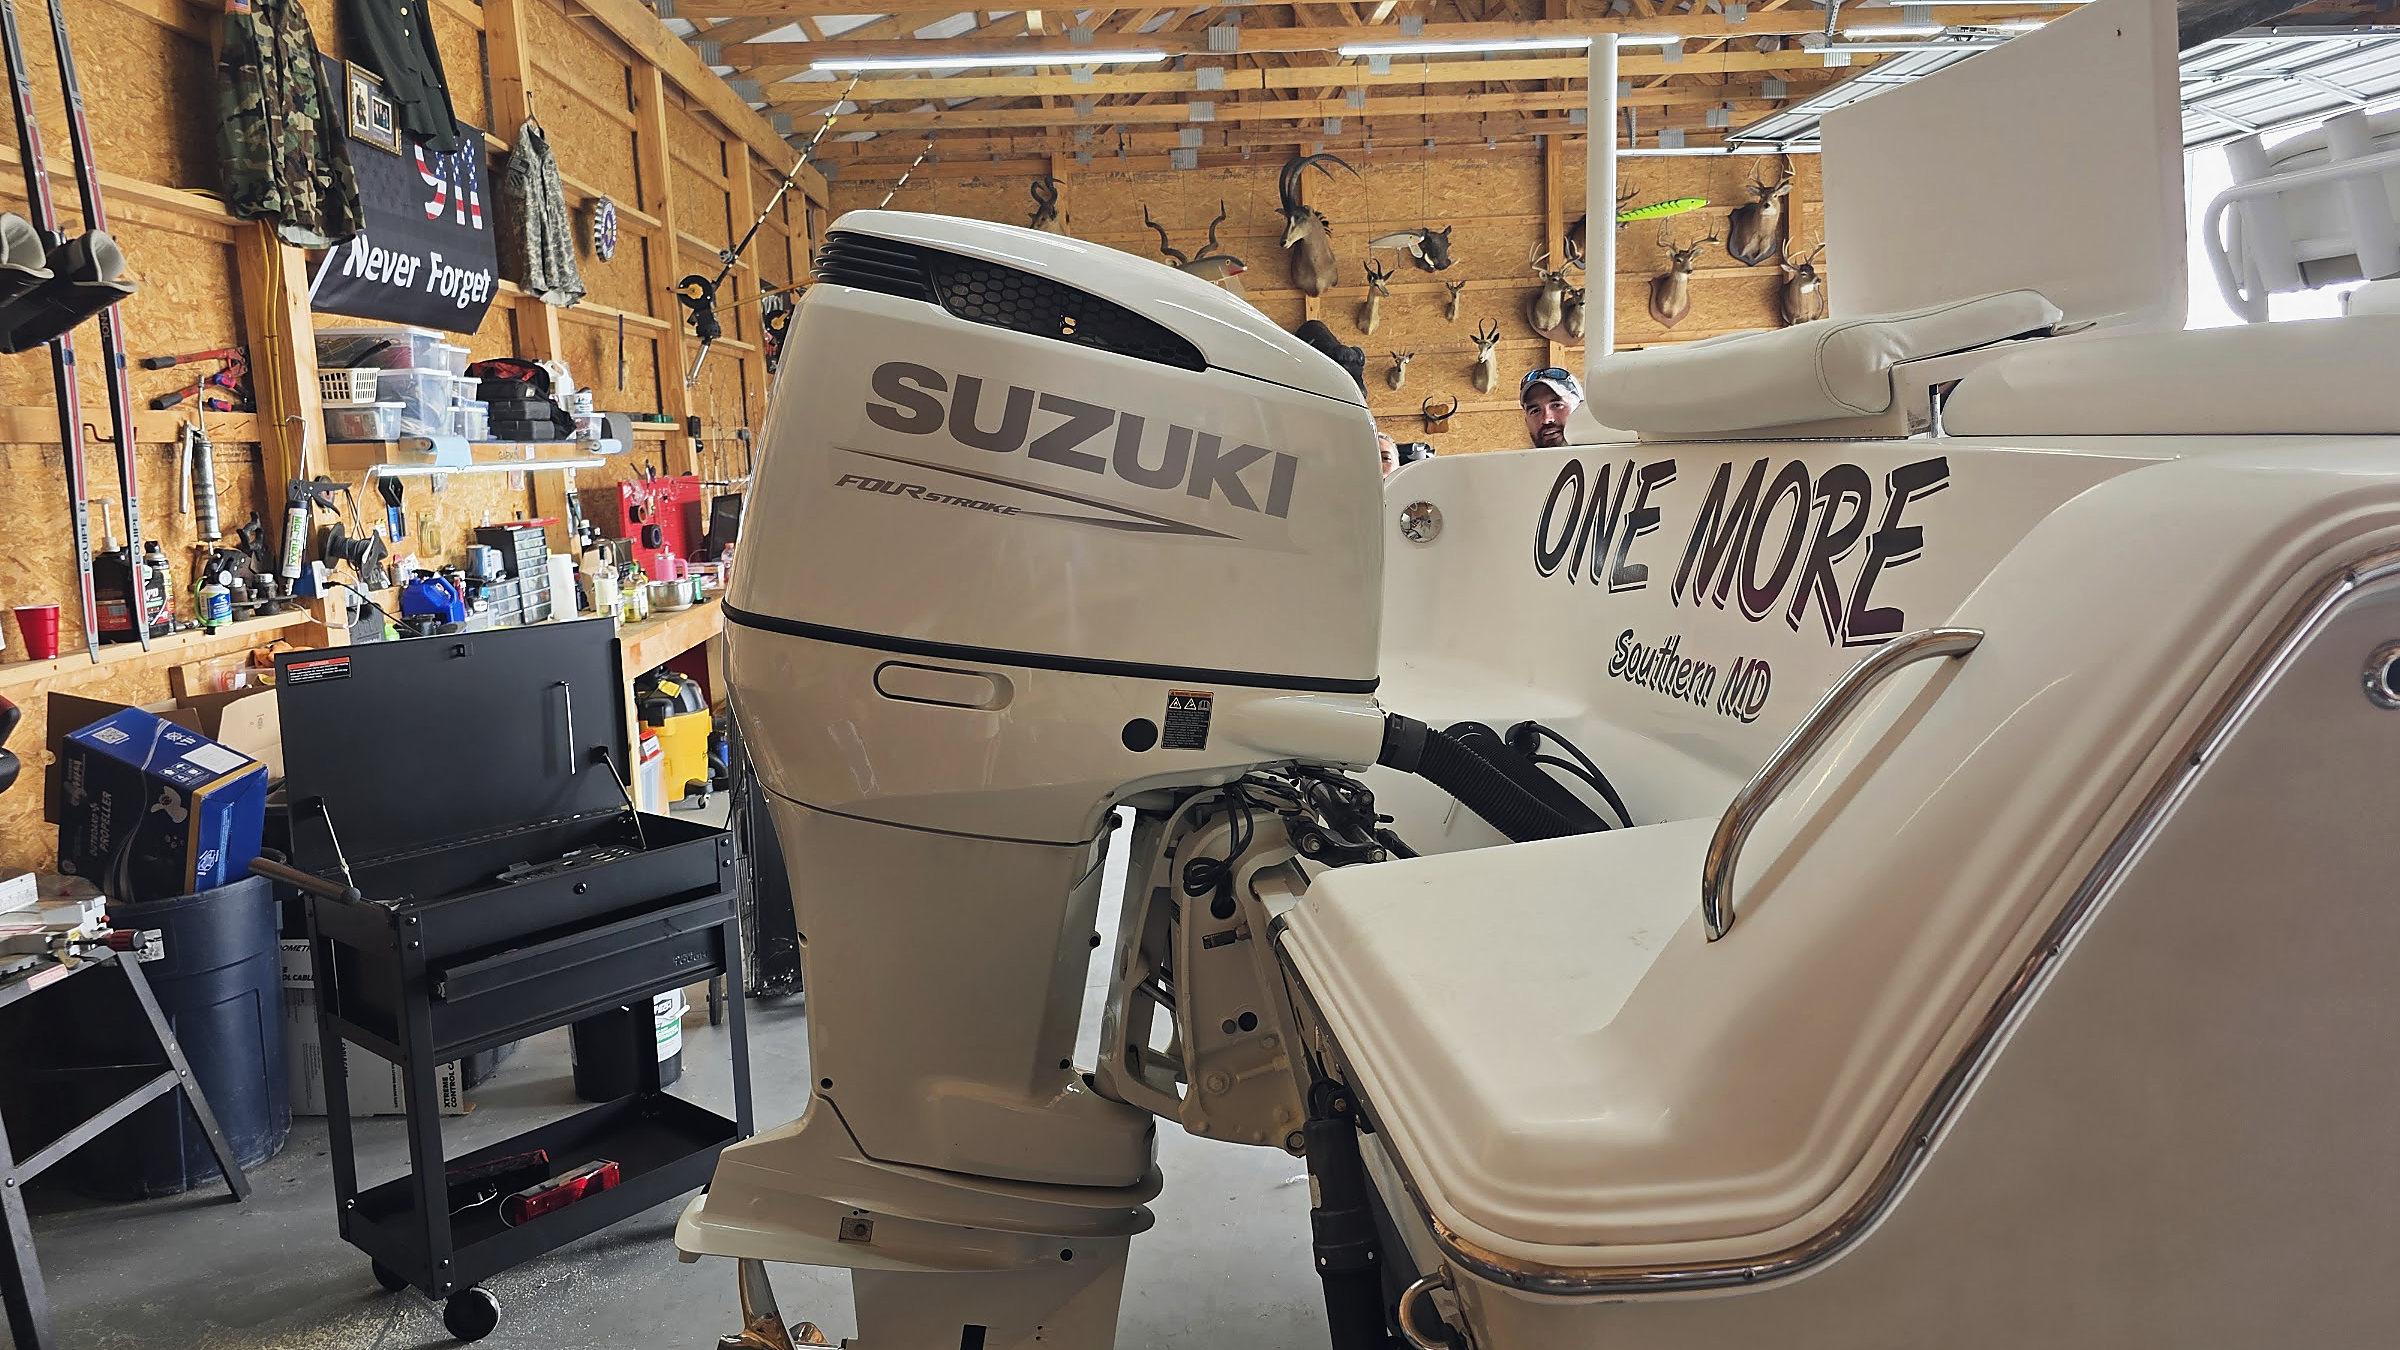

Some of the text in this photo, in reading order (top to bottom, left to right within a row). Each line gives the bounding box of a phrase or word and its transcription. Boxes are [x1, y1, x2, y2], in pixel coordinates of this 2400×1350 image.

[342, 233, 491, 309] Never Forget
[865, 361, 1298, 519] SUZUKI
[834, 474, 1023, 517] FOUR STROKE
[78, 502, 90, 572] EQUIPE R
[131, 513, 141, 565] EQUIPE
[1534, 456, 1950, 648] ONE MORE
[1607, 629, 1772, 724] Southern MD
[101, 790, 113, 853] PROPELLER
[281, 944, 311, 952] OMETI
[442, 1076, 451, 1108] XTREME
[449, 1072, 458, 1108] CONTROL
